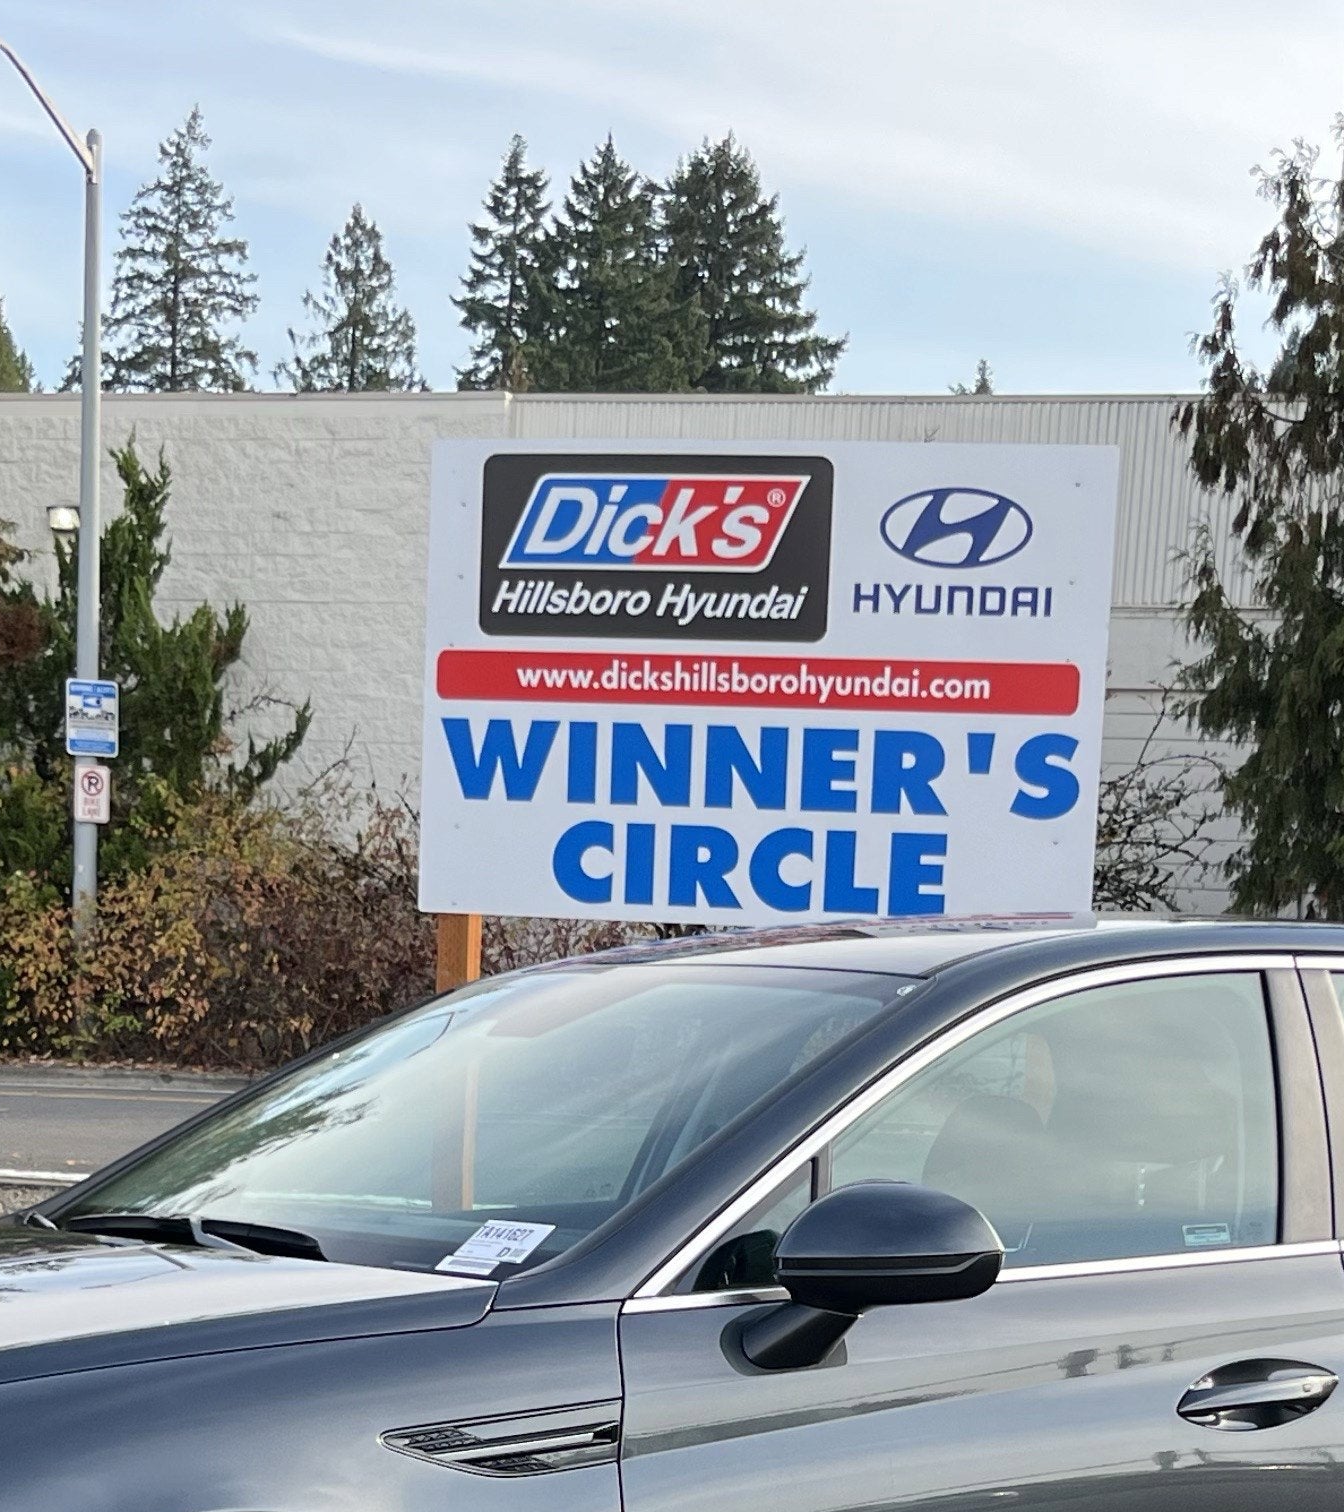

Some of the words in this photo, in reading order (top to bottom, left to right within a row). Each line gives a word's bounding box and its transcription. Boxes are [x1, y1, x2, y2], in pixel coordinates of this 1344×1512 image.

[491, 581, 651, 617] Hillsboro
[655, 583, 809, 627] Hyundai
[852, 582, 1053, 618] HYUNDAI
[516, 661, 991, 704] www.dickshillsborohyundai.com
[441, 717, 1081, 820] WINNER'S
[552, 820, 948, 916] CIRCLE
